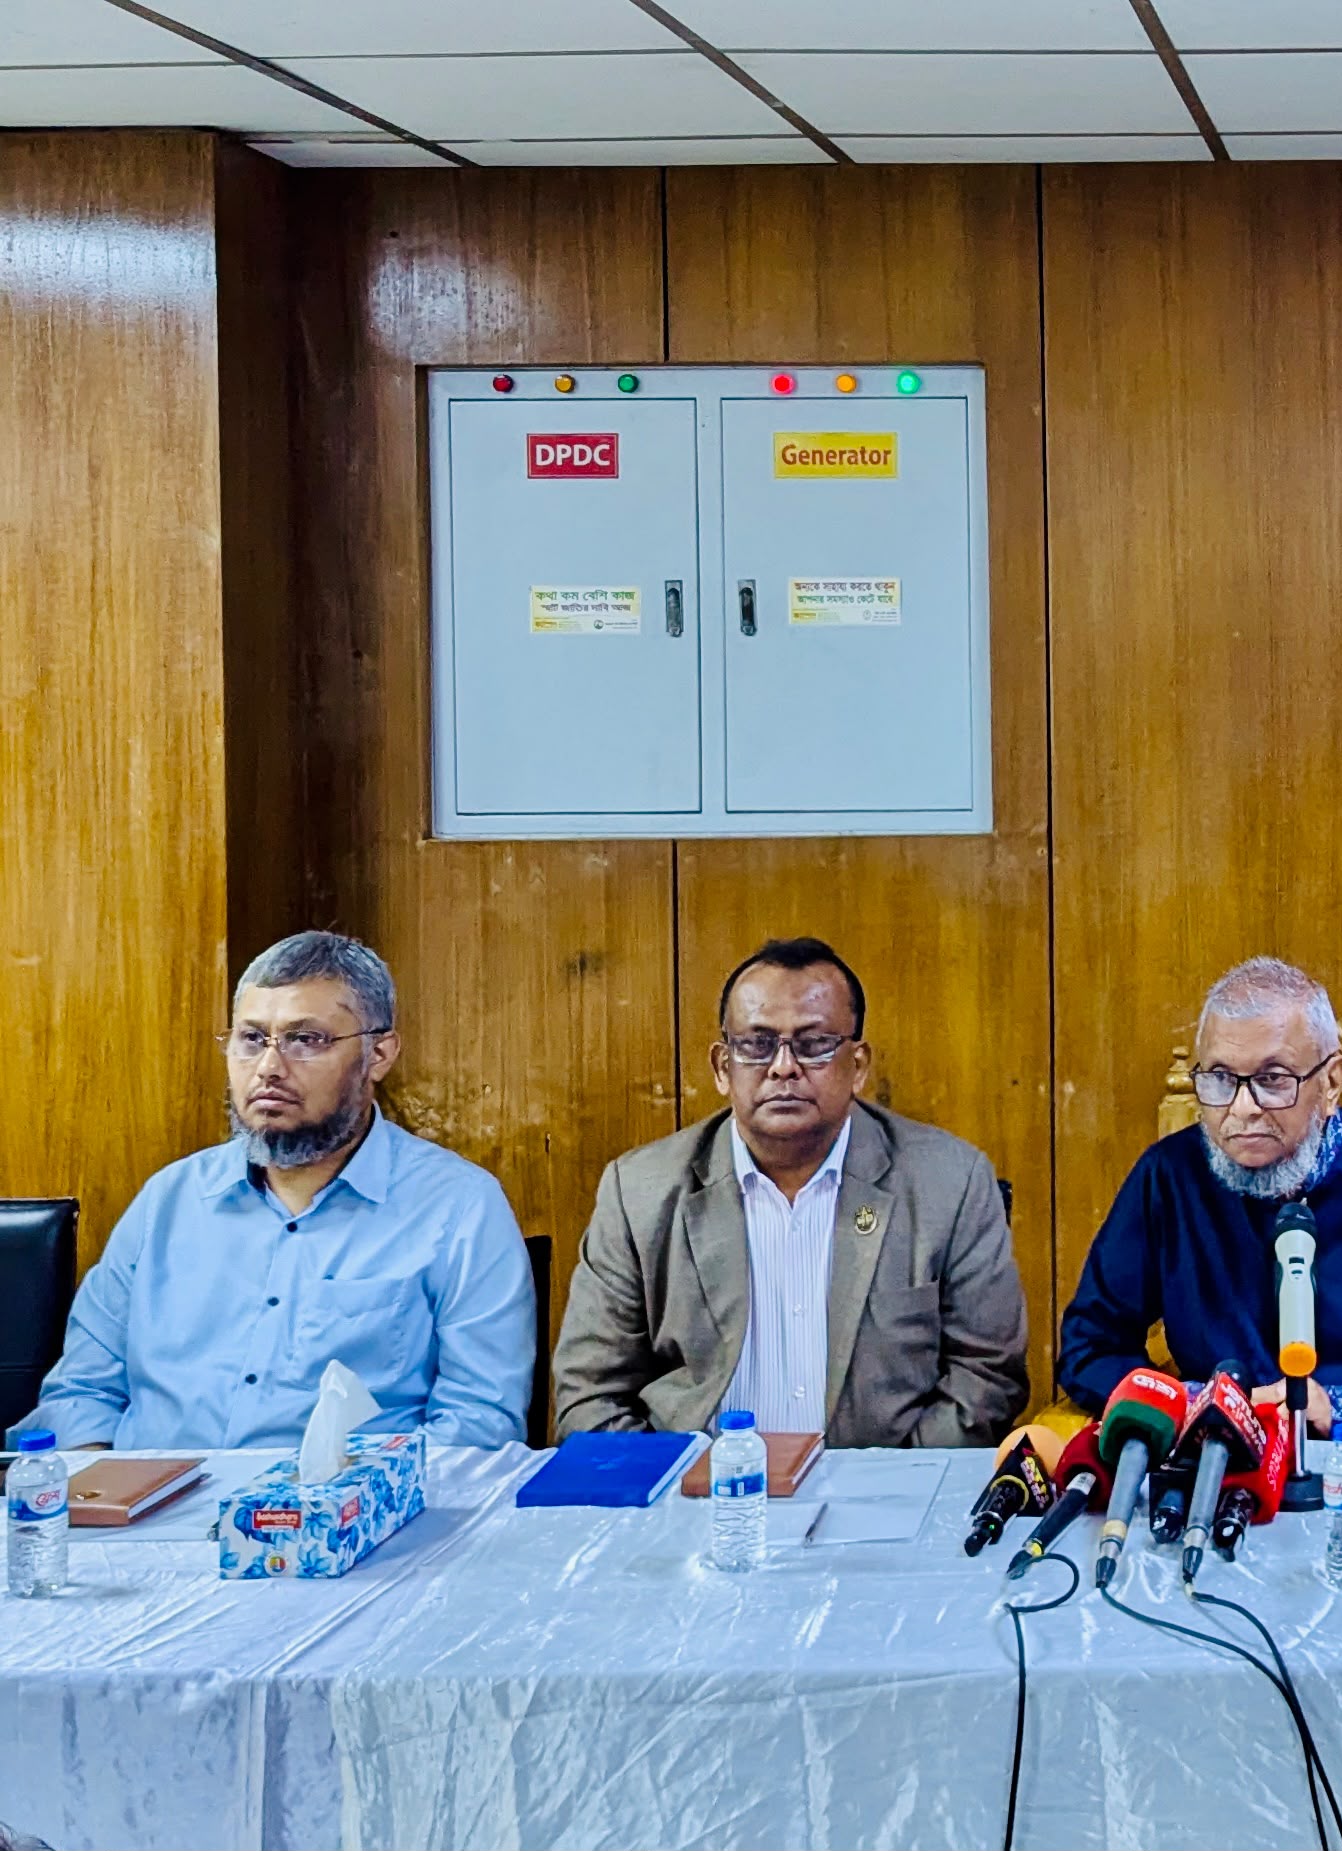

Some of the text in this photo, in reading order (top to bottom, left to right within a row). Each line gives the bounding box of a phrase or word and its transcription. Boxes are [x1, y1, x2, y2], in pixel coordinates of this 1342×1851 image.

[535, 443, 611, 467] DPDC
[781, 443, 893, 467] Generator
[535, 589, 636, 601] কথা কম বেশি কাজ
